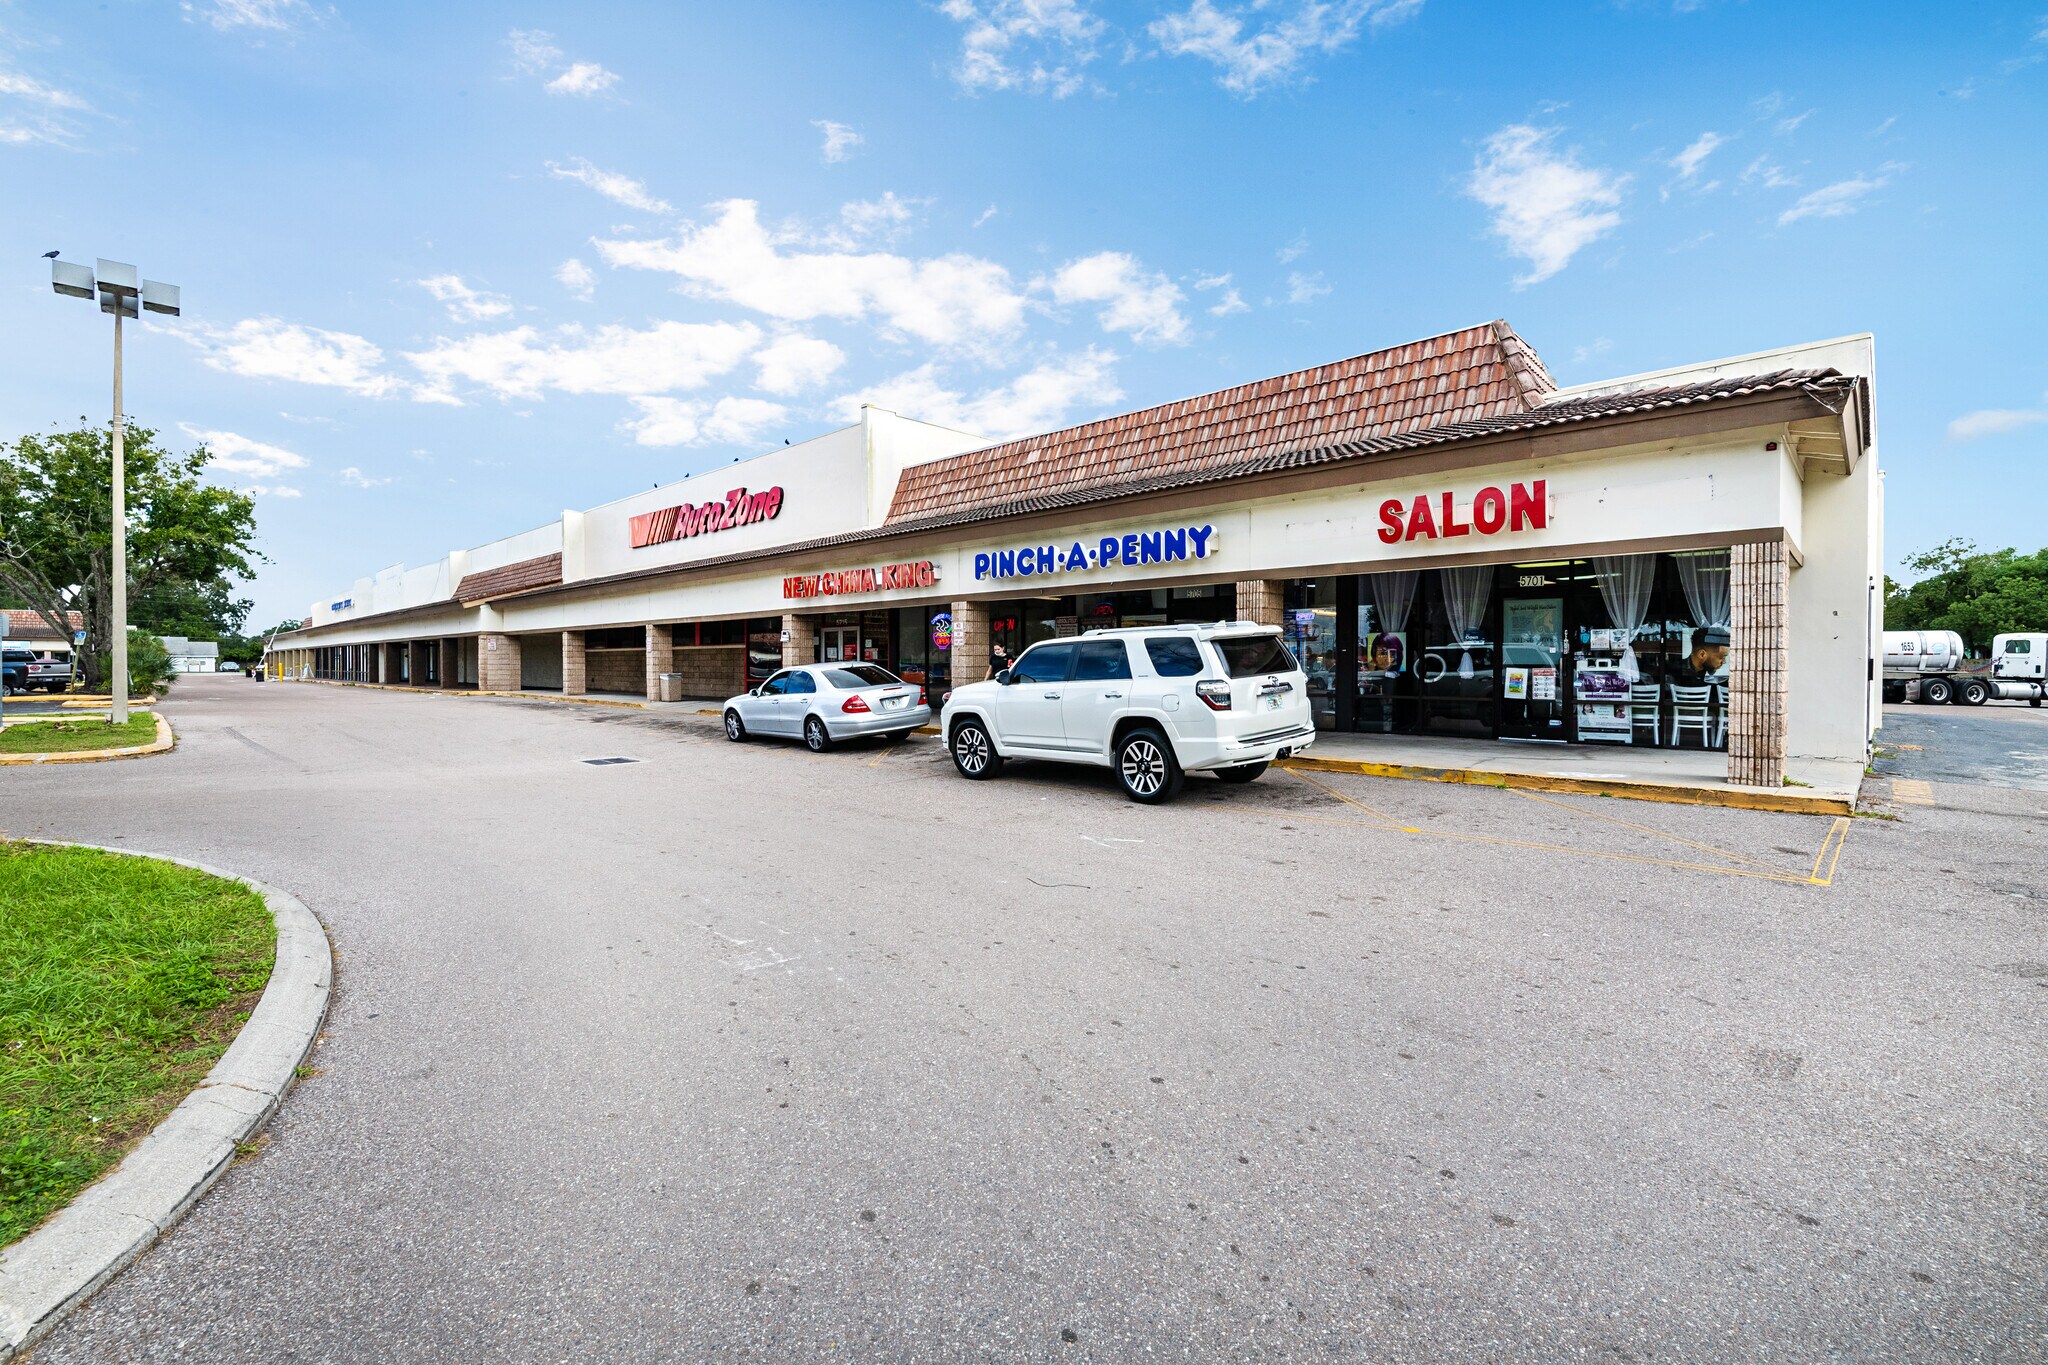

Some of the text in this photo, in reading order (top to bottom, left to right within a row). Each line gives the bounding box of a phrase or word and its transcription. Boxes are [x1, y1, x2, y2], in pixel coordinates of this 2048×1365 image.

[673, 486, 784, 541] AutoZone
[1377, 479, 1547, 545] SALON
[783, 560, 935, 598] NEW CHINA KING
[1520, 575, 1544, 587] 5701
[1094, 605, 1114, 616] OPEN
[936, 637, 951, 645] OPEN
[1901, 641, 1915, 652] 1653
